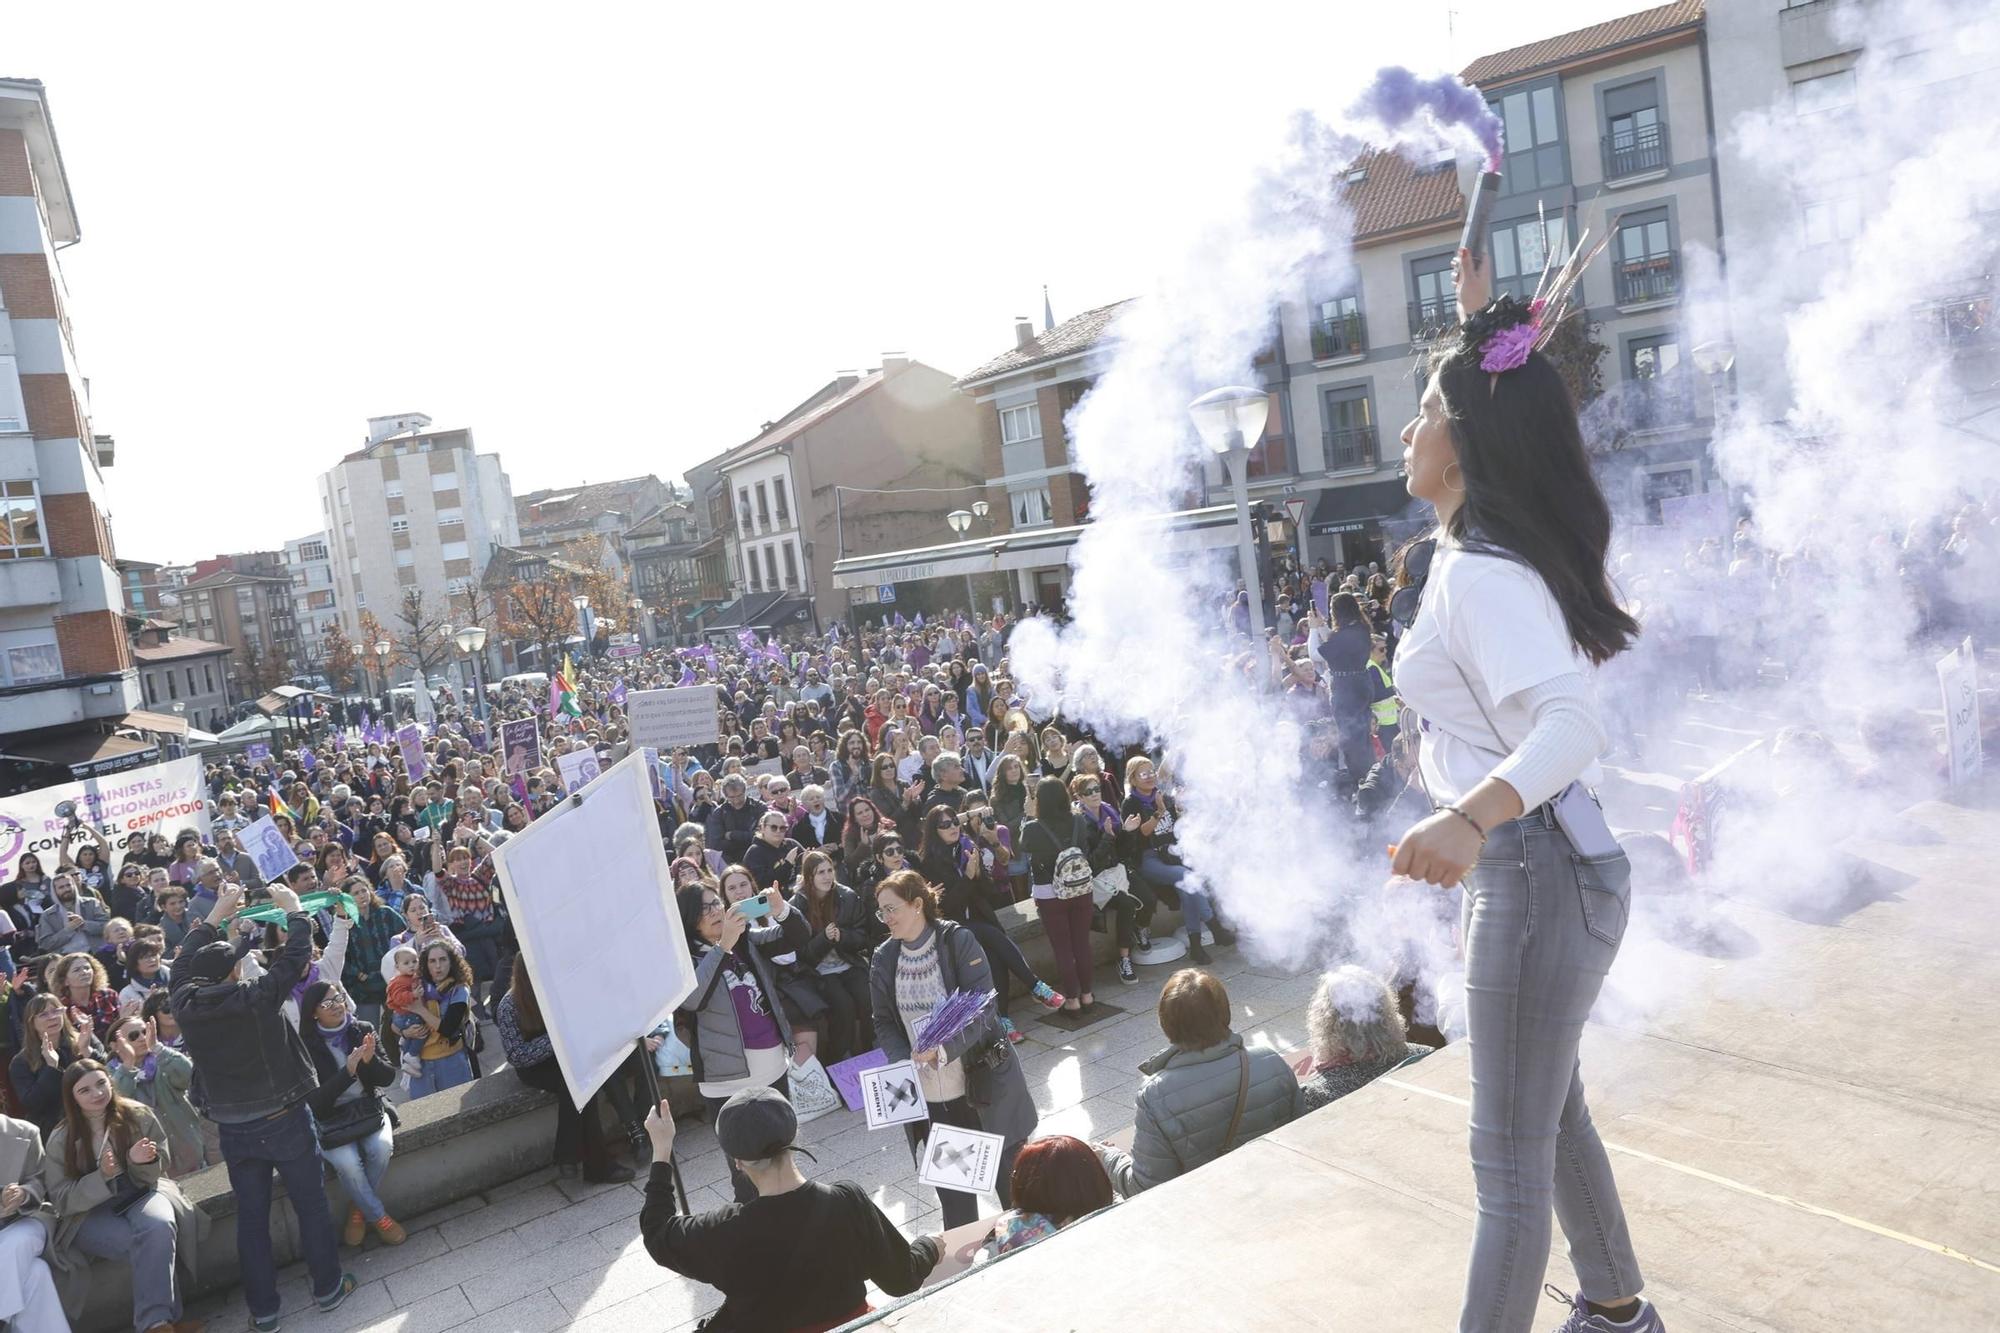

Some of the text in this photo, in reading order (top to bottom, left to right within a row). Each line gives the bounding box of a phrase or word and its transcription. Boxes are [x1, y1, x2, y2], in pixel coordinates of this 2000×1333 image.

[44, 787, 188, 832] REOLUCIONARIAS
[73, 778, 163, 807] FEMINISTAS
[103, 823, 121, 837] EL
[127, 800, 204, 830] GENOCIDIO
[871, 1081, 883, 1118] AUSENTE
[979, 1144, 991, 1182] AUSENTE
